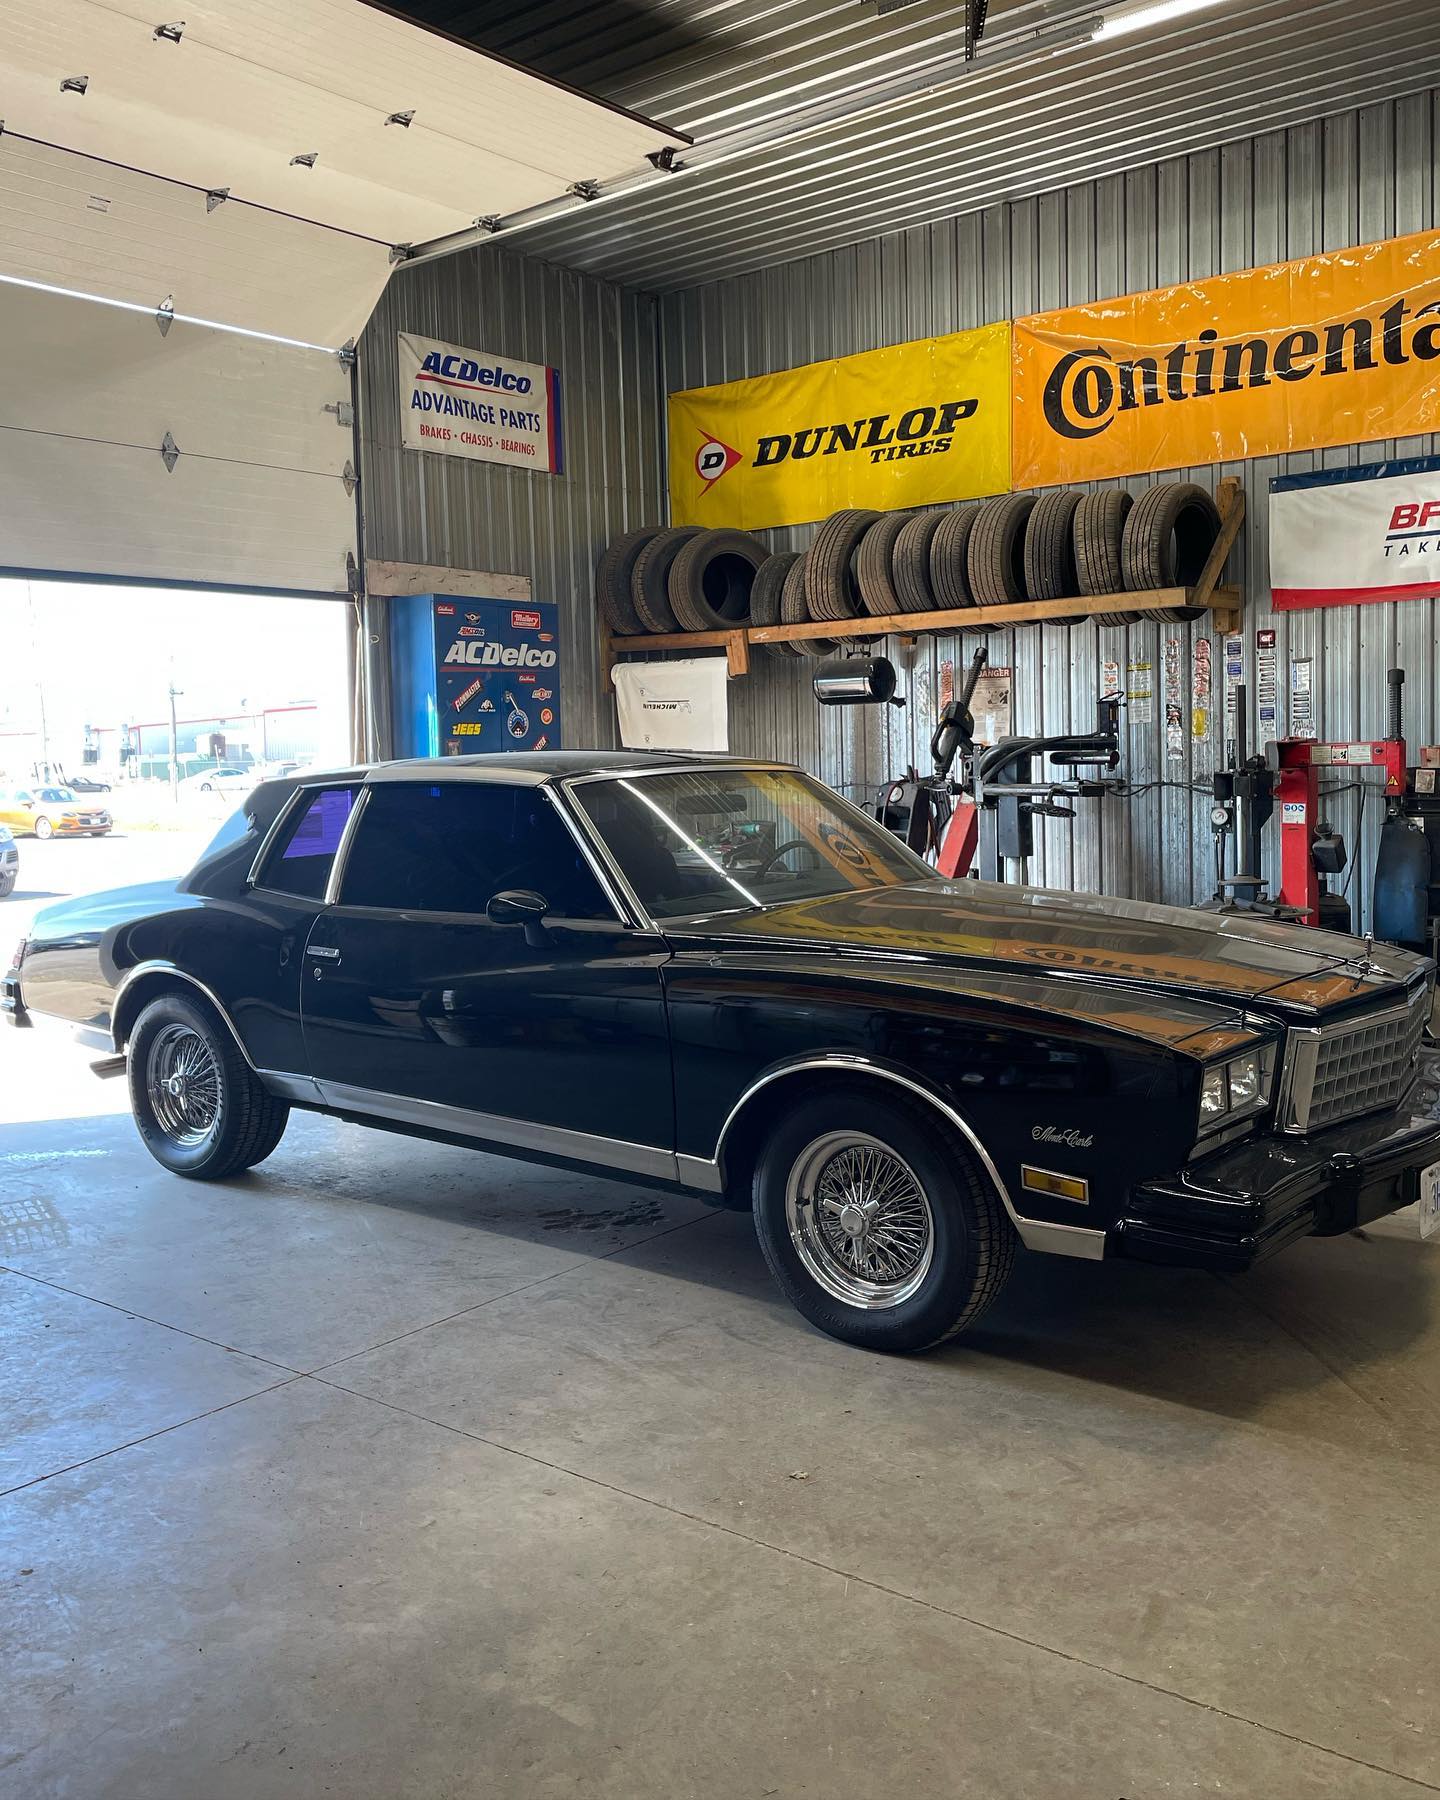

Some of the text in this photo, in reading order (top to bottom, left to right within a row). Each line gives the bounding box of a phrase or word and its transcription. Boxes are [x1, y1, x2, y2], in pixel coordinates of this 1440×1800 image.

[421, 351, 531, 394] ACDelco
[411, 389, 540, 433] ADVANTAGE PARTS
[420, 424, 535, 456] BRAKES CHASSIS BEARINGS
[752, 398, 979, 468] DUNLOP
[870, 437, 952, 464] TIRES
[444, 640, 557, 668] ACDelco
[453, 723, 482, 736] JEGS
[1031, 1125, 1094, 1148] Monte Carlo
